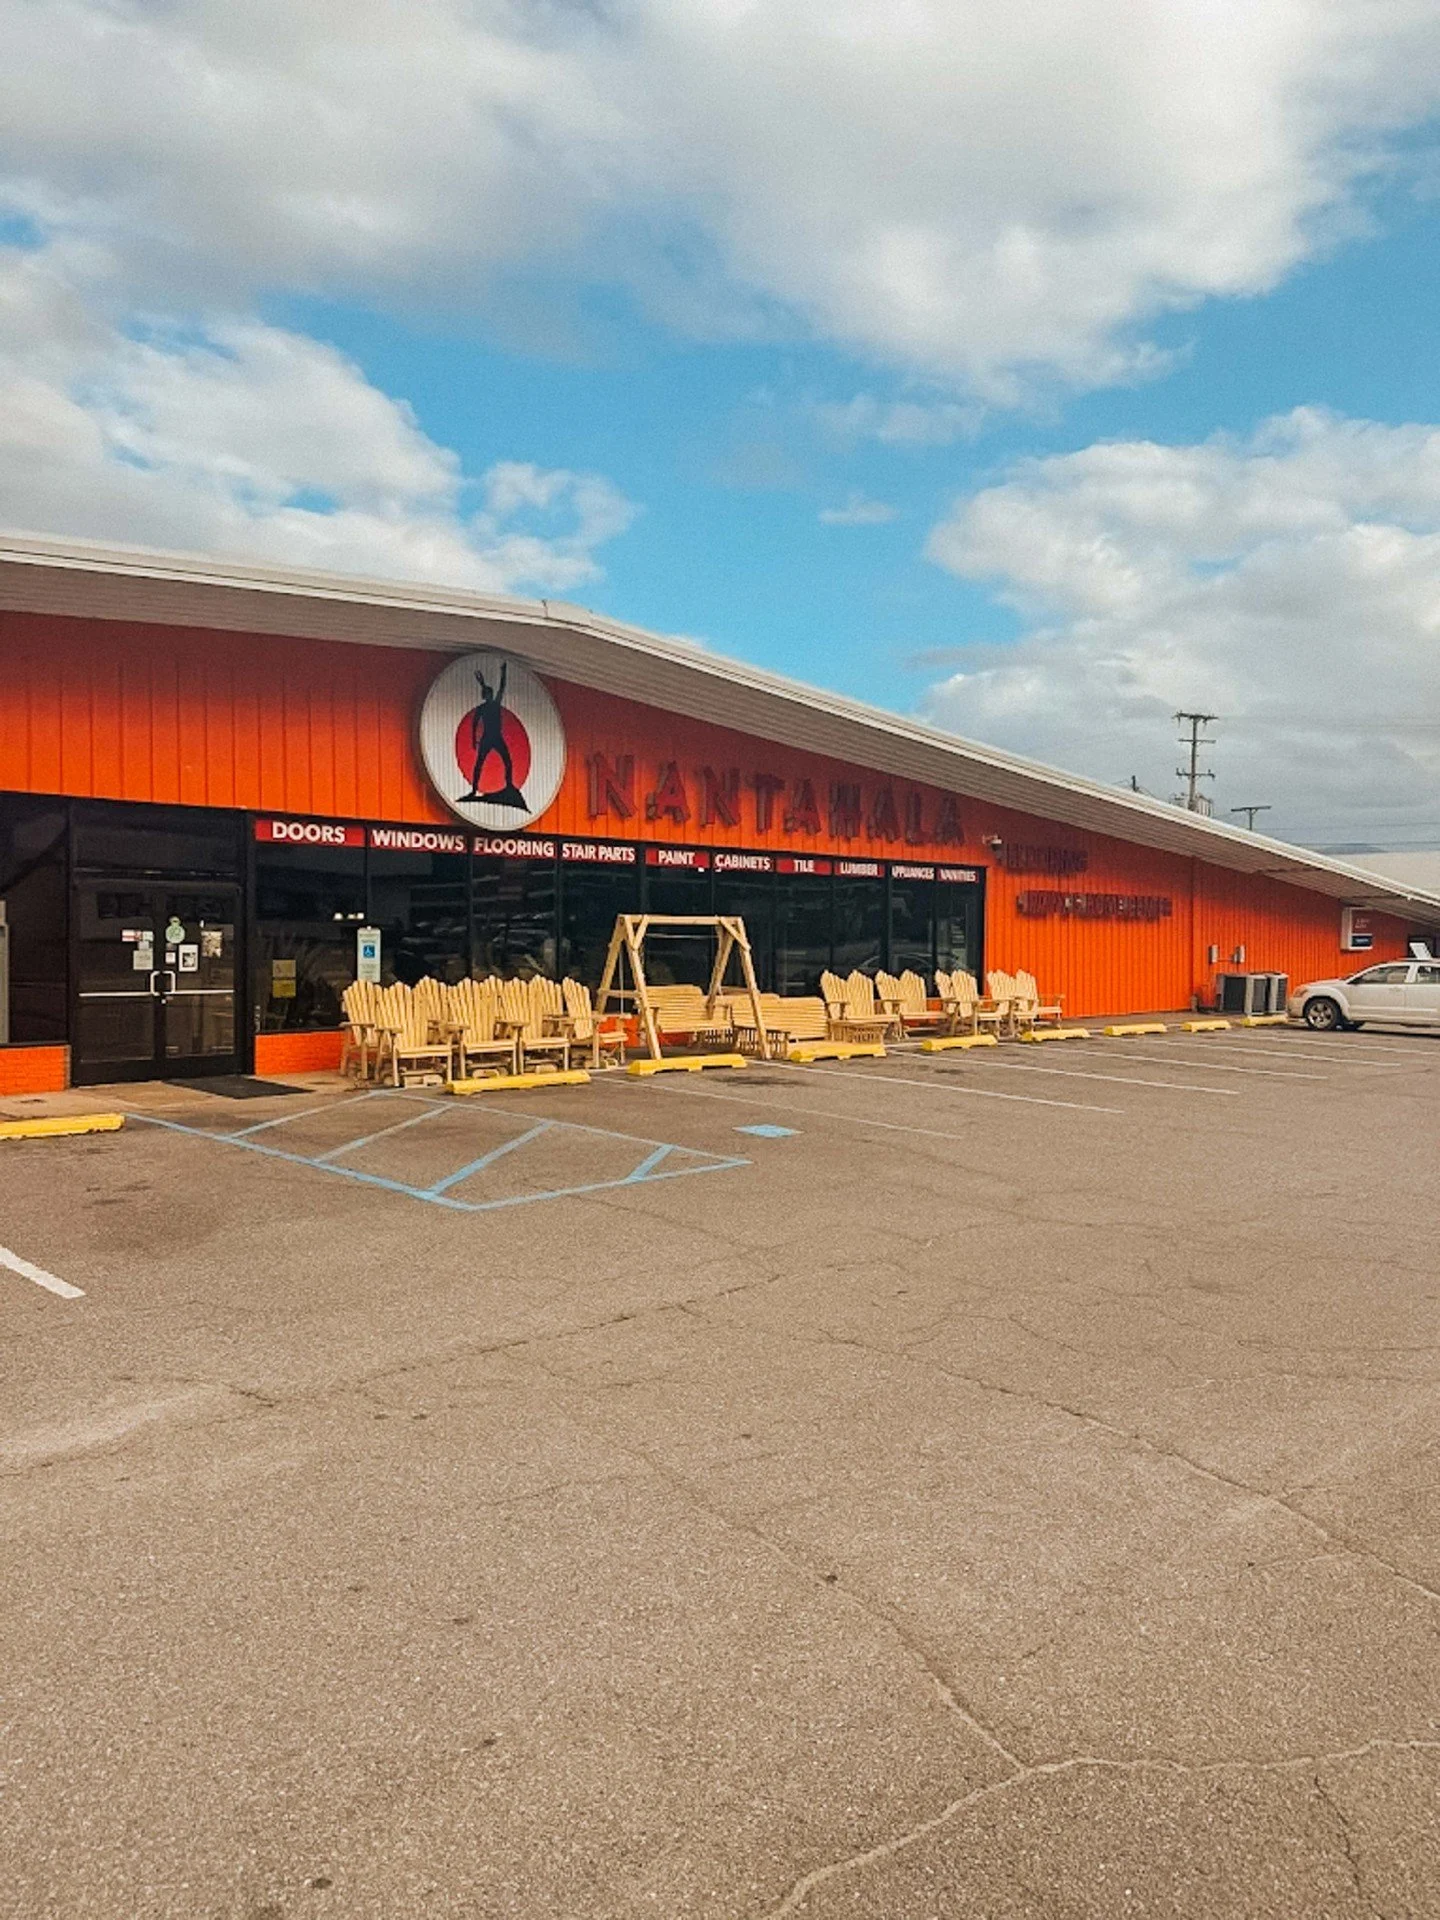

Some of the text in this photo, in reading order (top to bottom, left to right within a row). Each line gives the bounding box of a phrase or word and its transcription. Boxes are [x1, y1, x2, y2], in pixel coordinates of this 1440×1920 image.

[272, 821, 346, 844] DOORS
[372, 828, 465, 851] WINDOWS
[474, 836, 554, 858] FLOORING
[562, 842, 636, 863] STAIR PARTS
[658, 850, 695, 865] PAINT
[715, 853, 771, 870] CABINETS
[793, 859, 815, 873] TILE
[840, 861, 878, 877] LUMBER
[891, 865, 935, 881] APPLIANCES
[940, 868, 976, 882] VANITIES
